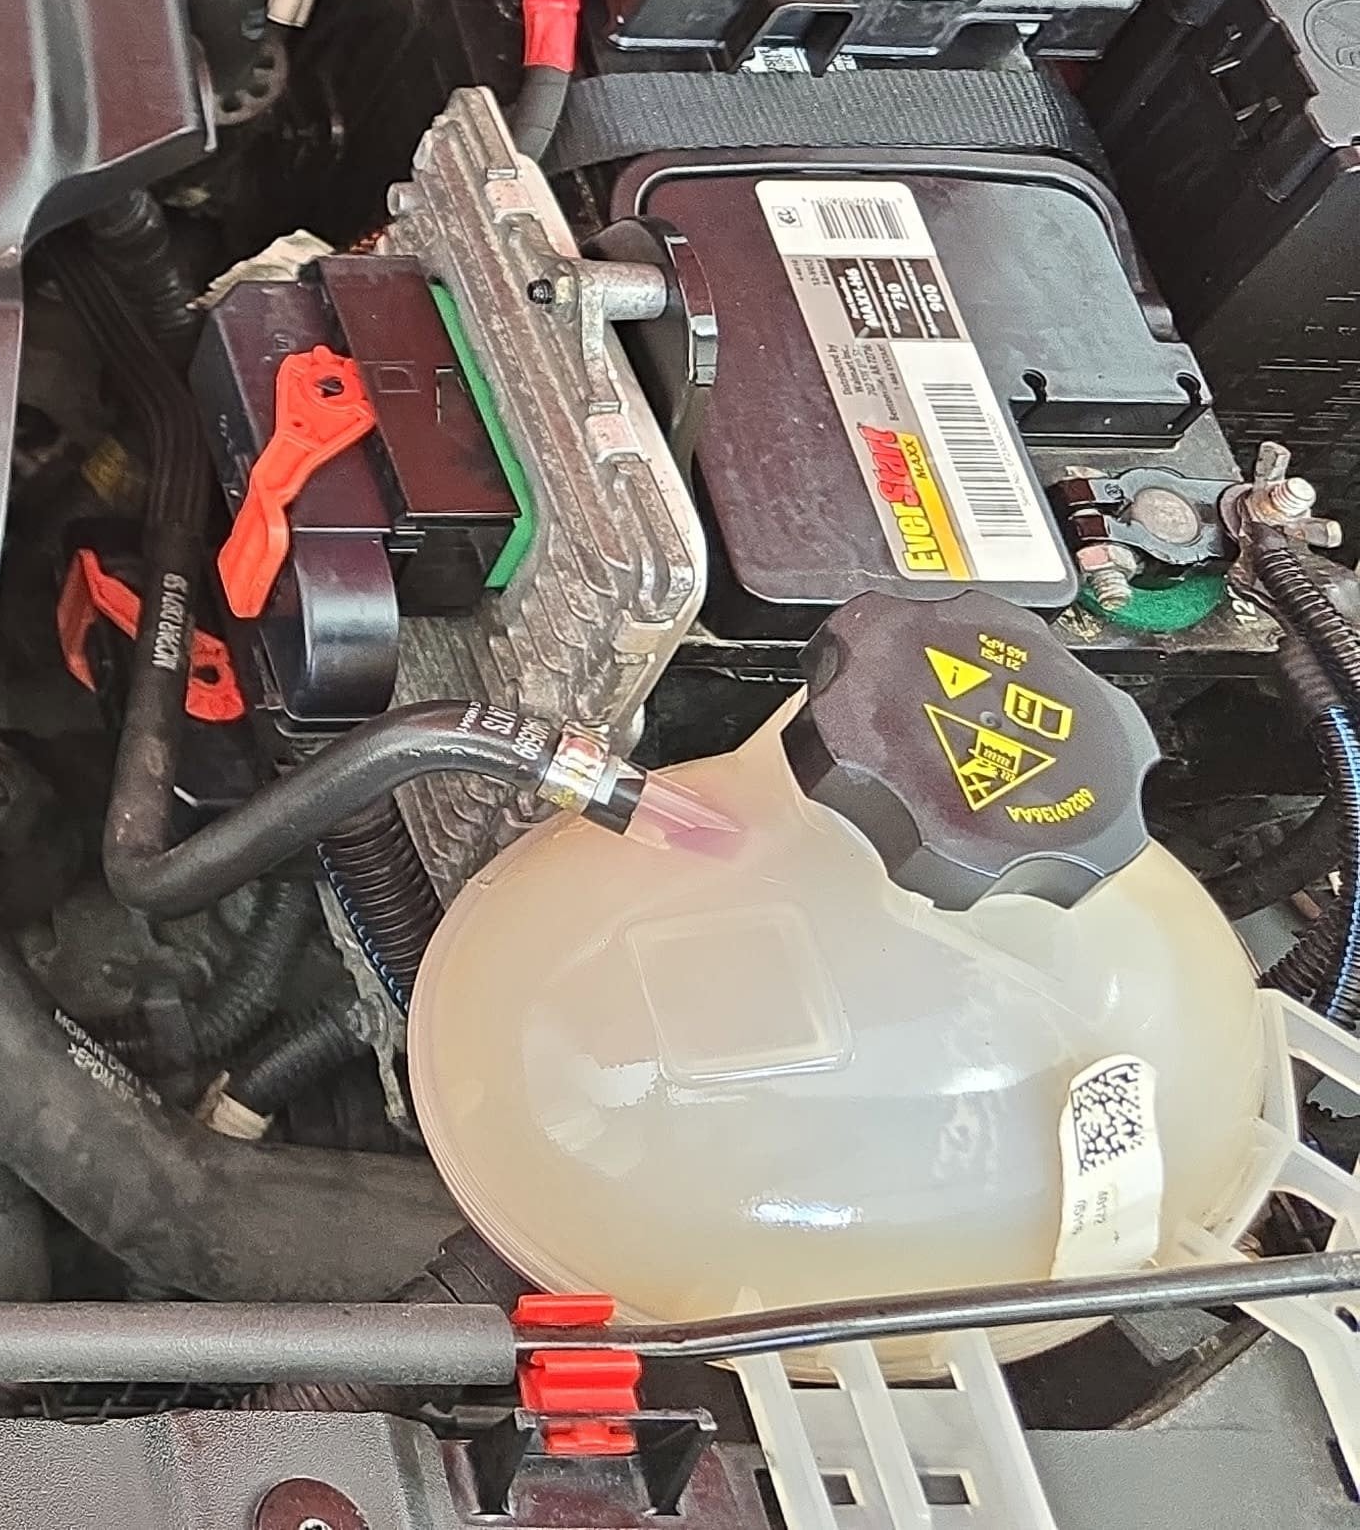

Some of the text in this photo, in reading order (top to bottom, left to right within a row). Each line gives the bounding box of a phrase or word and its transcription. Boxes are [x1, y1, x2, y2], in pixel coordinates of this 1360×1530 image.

[843, 267, 881, 327] MAXX-H6
[885, 282, 911, 310] 730
[920, 283, 946, 311] 900
[825, 343, 853, 395] Distributed by
[844, 360, 864, 392] Walmart
[868, 364, 881, 374] AR
[901, 438, 928, 479] MAXX
[855, 426, 947, 571] EverStart
[978, 633, 1028, 662] 145 kPa
[980, 646, 1022, 672] 21 PSI
[1005, 787, 1096, 823] 68249136AA
[53, 1008, 106, 1065] MOPAR
